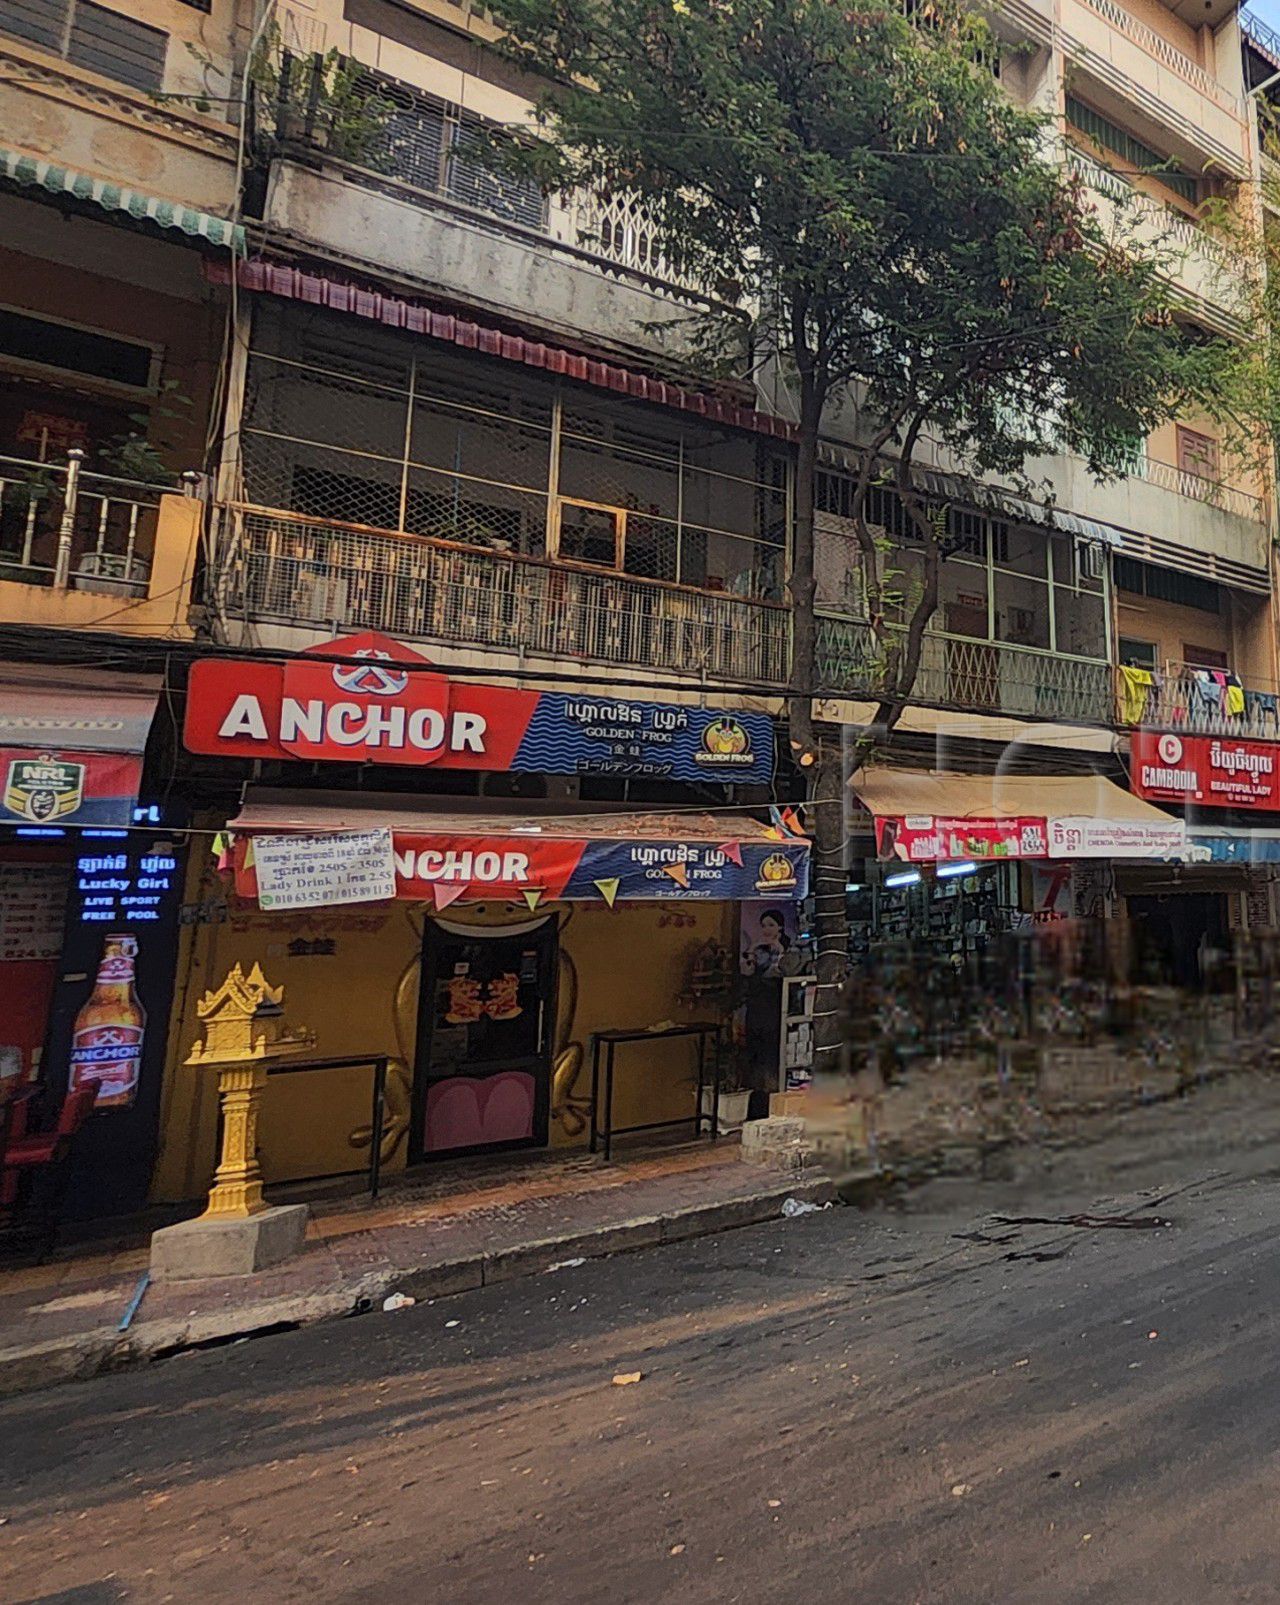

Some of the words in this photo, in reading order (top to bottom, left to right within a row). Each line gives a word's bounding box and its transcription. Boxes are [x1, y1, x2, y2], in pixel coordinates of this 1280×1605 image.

[218, 694, 486, 752] ANCHOR
[585, 727, 634, 741] GOLDEN
[642, 730, 672, 743] FROG
[22, 766, 74, 781] NRL
[1142, 765, 1197, 791] CAMBODIA
[1210, 780, 1251, 795] BEAUTIFUL
[1252, 785, 1272, 798] LADY
[134, 805, 160, 821] rl
[395, 850, 529, 881] NCHOR
[645, 869, 690, 879] GOLN
[693, 869, 722, 879] FROG
[79, 878, 130, 891] Lucky
[137, 878, 169, 889] Girl
[261, 881, 293, 891] Lady
[296, 877, 332, 888] Drink
[84, 896, 114, 906] LIVE
[275, 894, 293, 904] 010
[82, 911, 117, 921] FREE
[126, 911, 160, 920] POOL
[71, 1048, 140, 1062] ANCHOR
